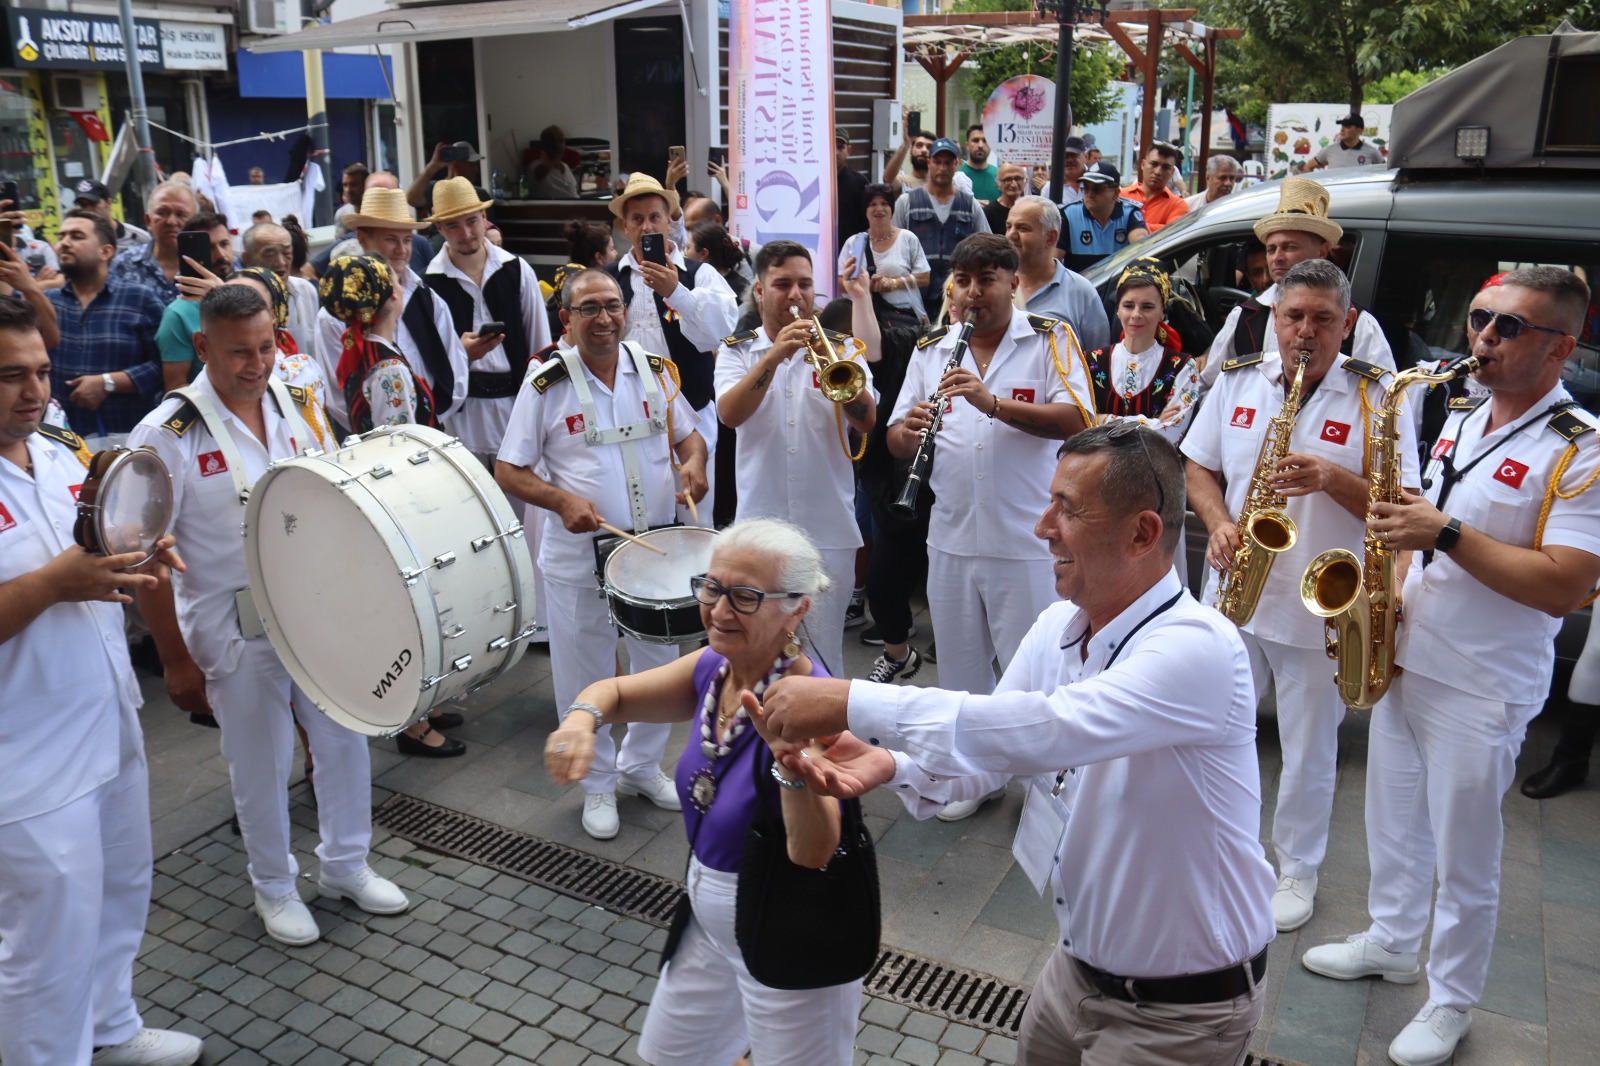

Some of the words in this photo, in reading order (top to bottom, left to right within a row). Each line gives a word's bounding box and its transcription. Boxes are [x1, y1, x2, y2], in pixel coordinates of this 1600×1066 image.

[41, 18, 90, 42] AKSOY
[92, 21, 157, 46] ANATAR
[42, 41, 89, 61] ÇİLİNGİR
[166, 50, 192, 58] Hakan
[194, 49, 222, 60] ÖZKAN
[1017, 135, 1053, 143] FESTİVAL
[372, 648, 413, 700] GEWA
